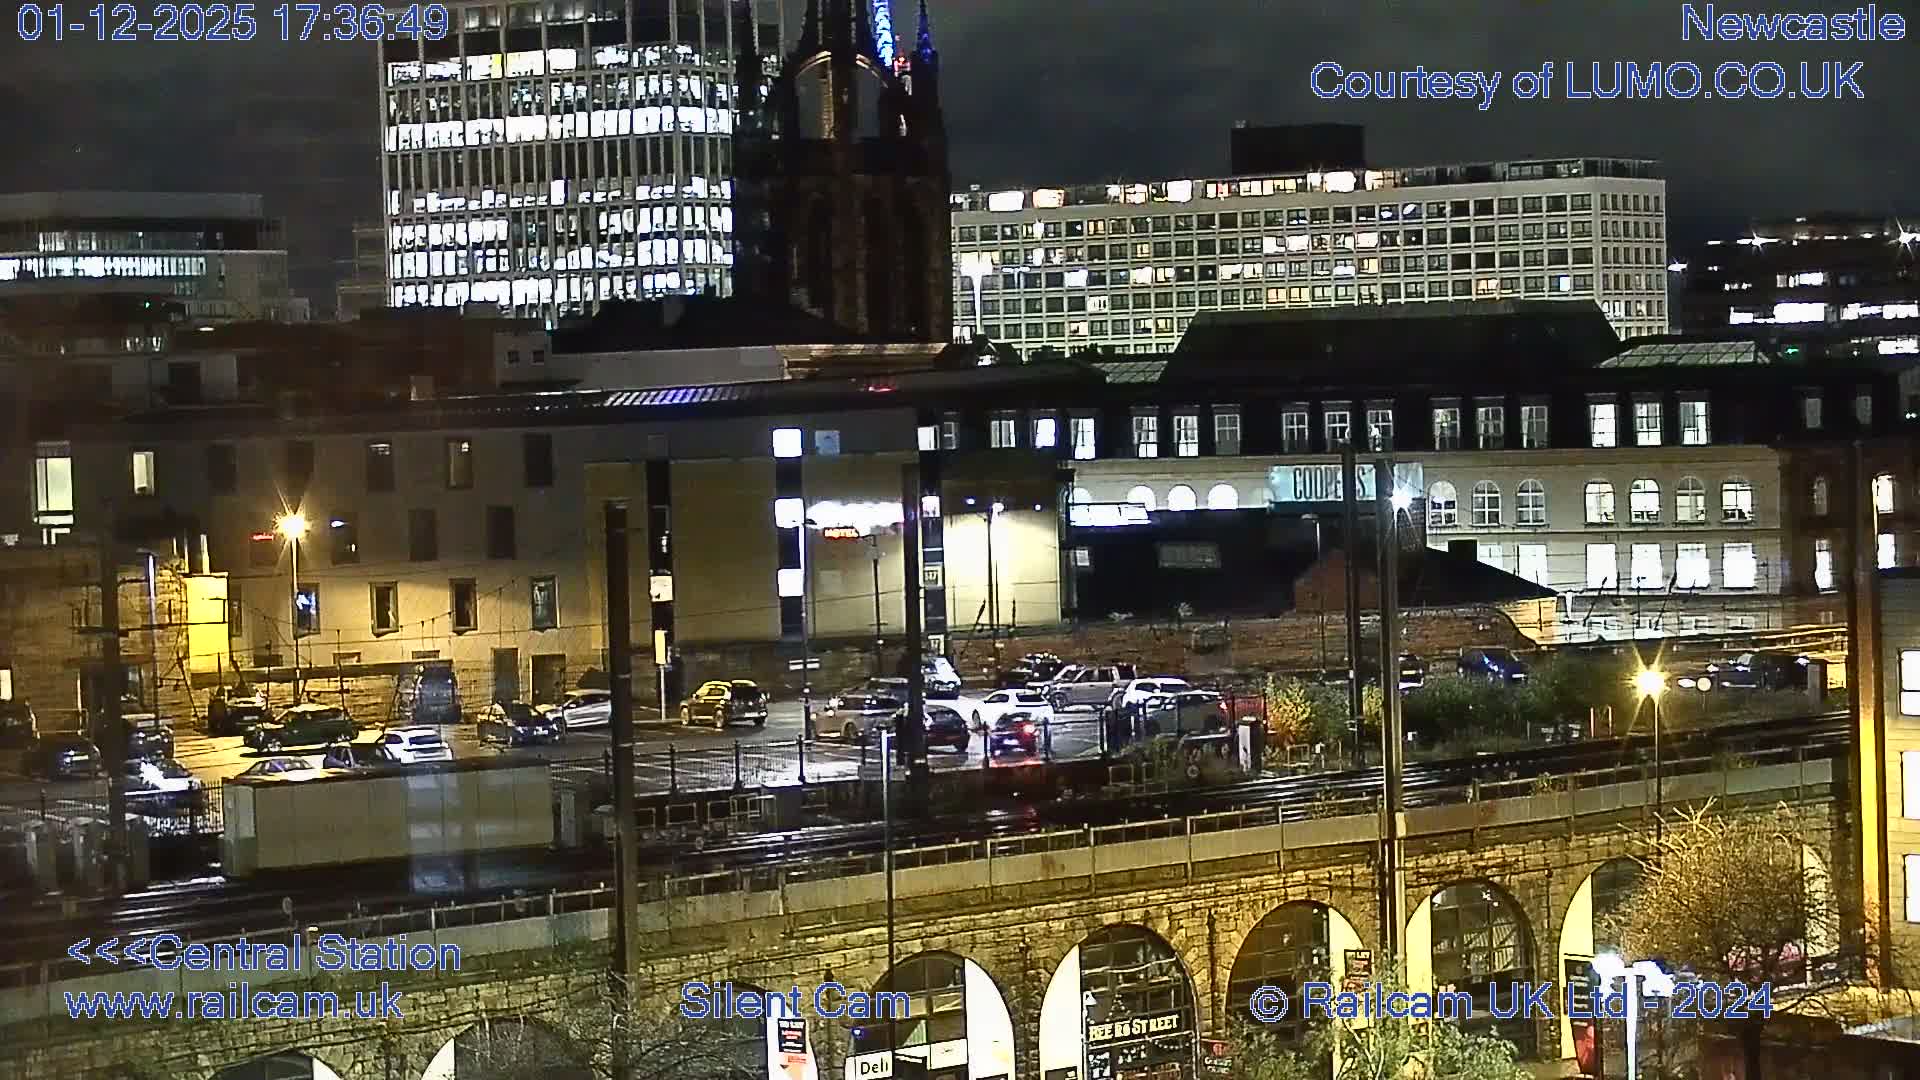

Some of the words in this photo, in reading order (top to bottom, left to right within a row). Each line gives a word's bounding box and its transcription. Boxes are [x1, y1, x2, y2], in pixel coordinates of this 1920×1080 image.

[1293, 466, 1367, 499] COOPES
[1132, 1014, 1180, 1035] STREET
[860, 1057, 889, 1075] Deli
